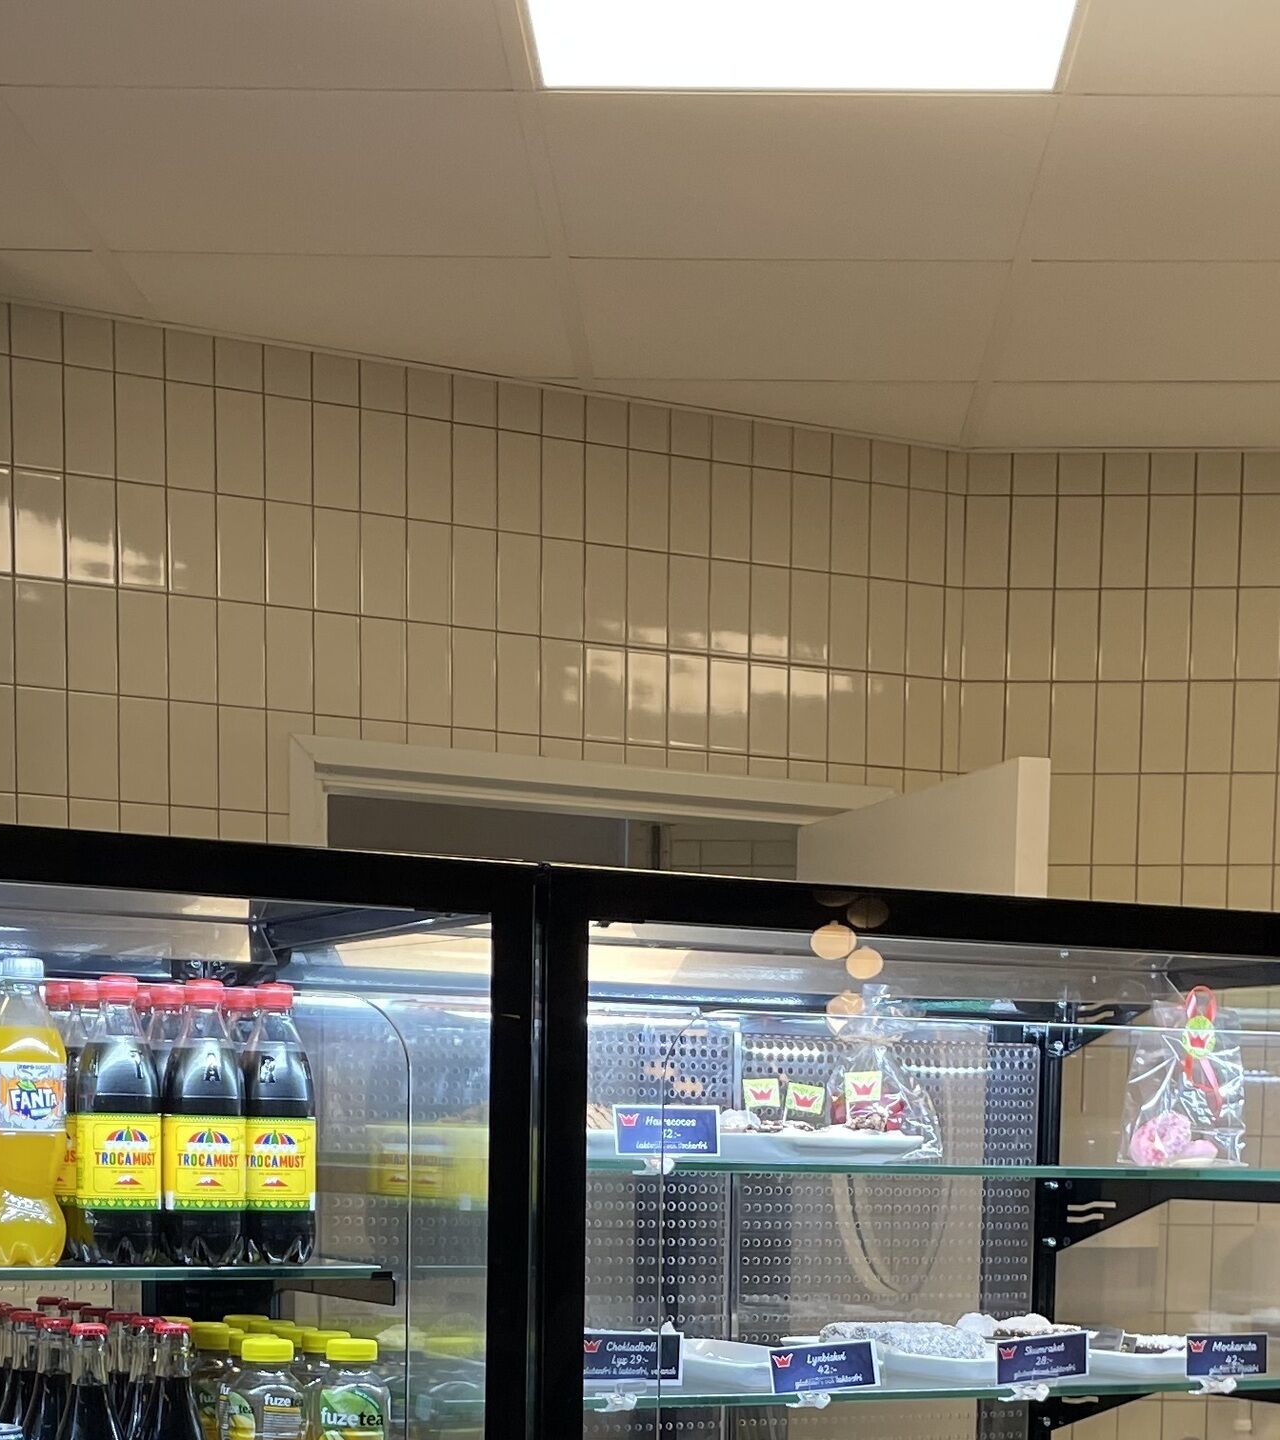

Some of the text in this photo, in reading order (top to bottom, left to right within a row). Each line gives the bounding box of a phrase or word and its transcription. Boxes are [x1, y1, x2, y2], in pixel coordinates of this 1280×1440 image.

[10, 1087, 58, 1110] FANTA
[95, 1151, 156, 1166] TROCAMUST
[177, 1153, 240, 1167] TROCAMUST
[246, 1154, 306, 1168] TROCAMUST
